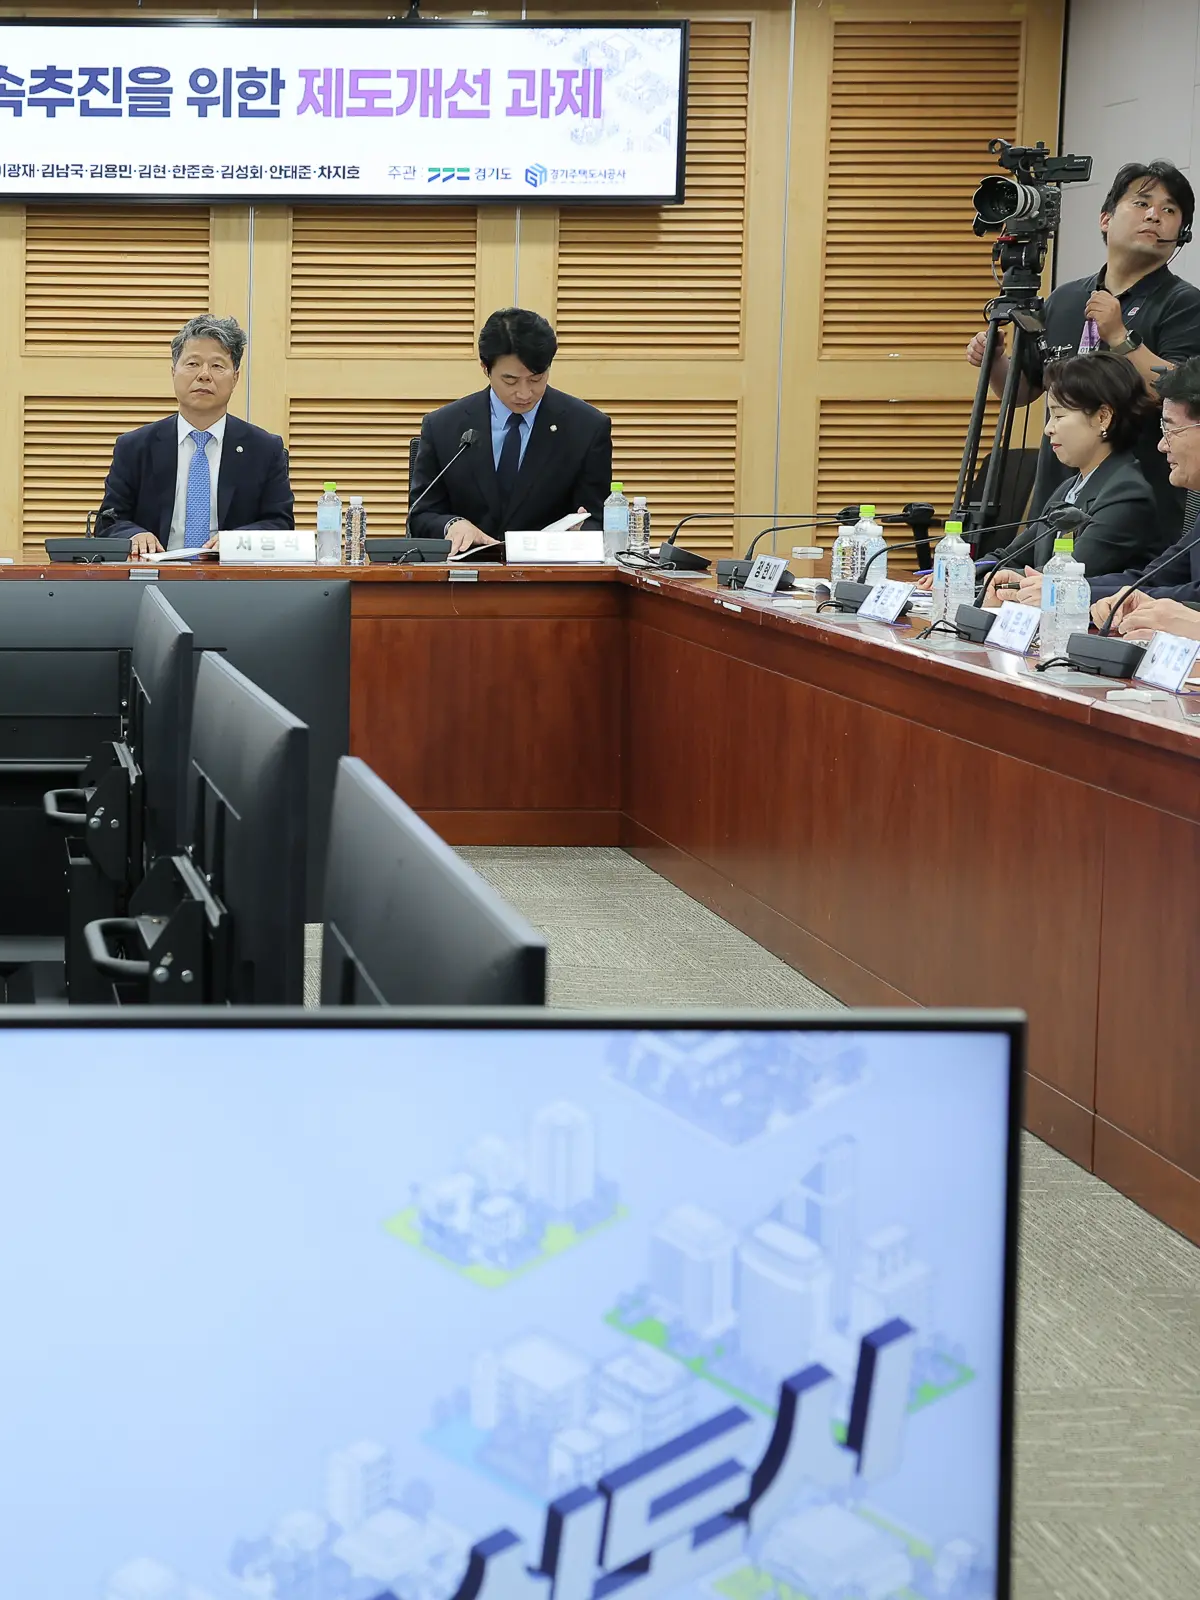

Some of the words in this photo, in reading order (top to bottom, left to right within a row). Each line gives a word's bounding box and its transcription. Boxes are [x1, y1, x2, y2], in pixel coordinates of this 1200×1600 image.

[186, 66, 286, 118] 위한
[297, 68, 491, 119] 제도개선
[506, 67, 604, 119] 과제
[474, 167, 512, 181] 경기도
[550, 168, 626, 180] 경기주택도시공사
